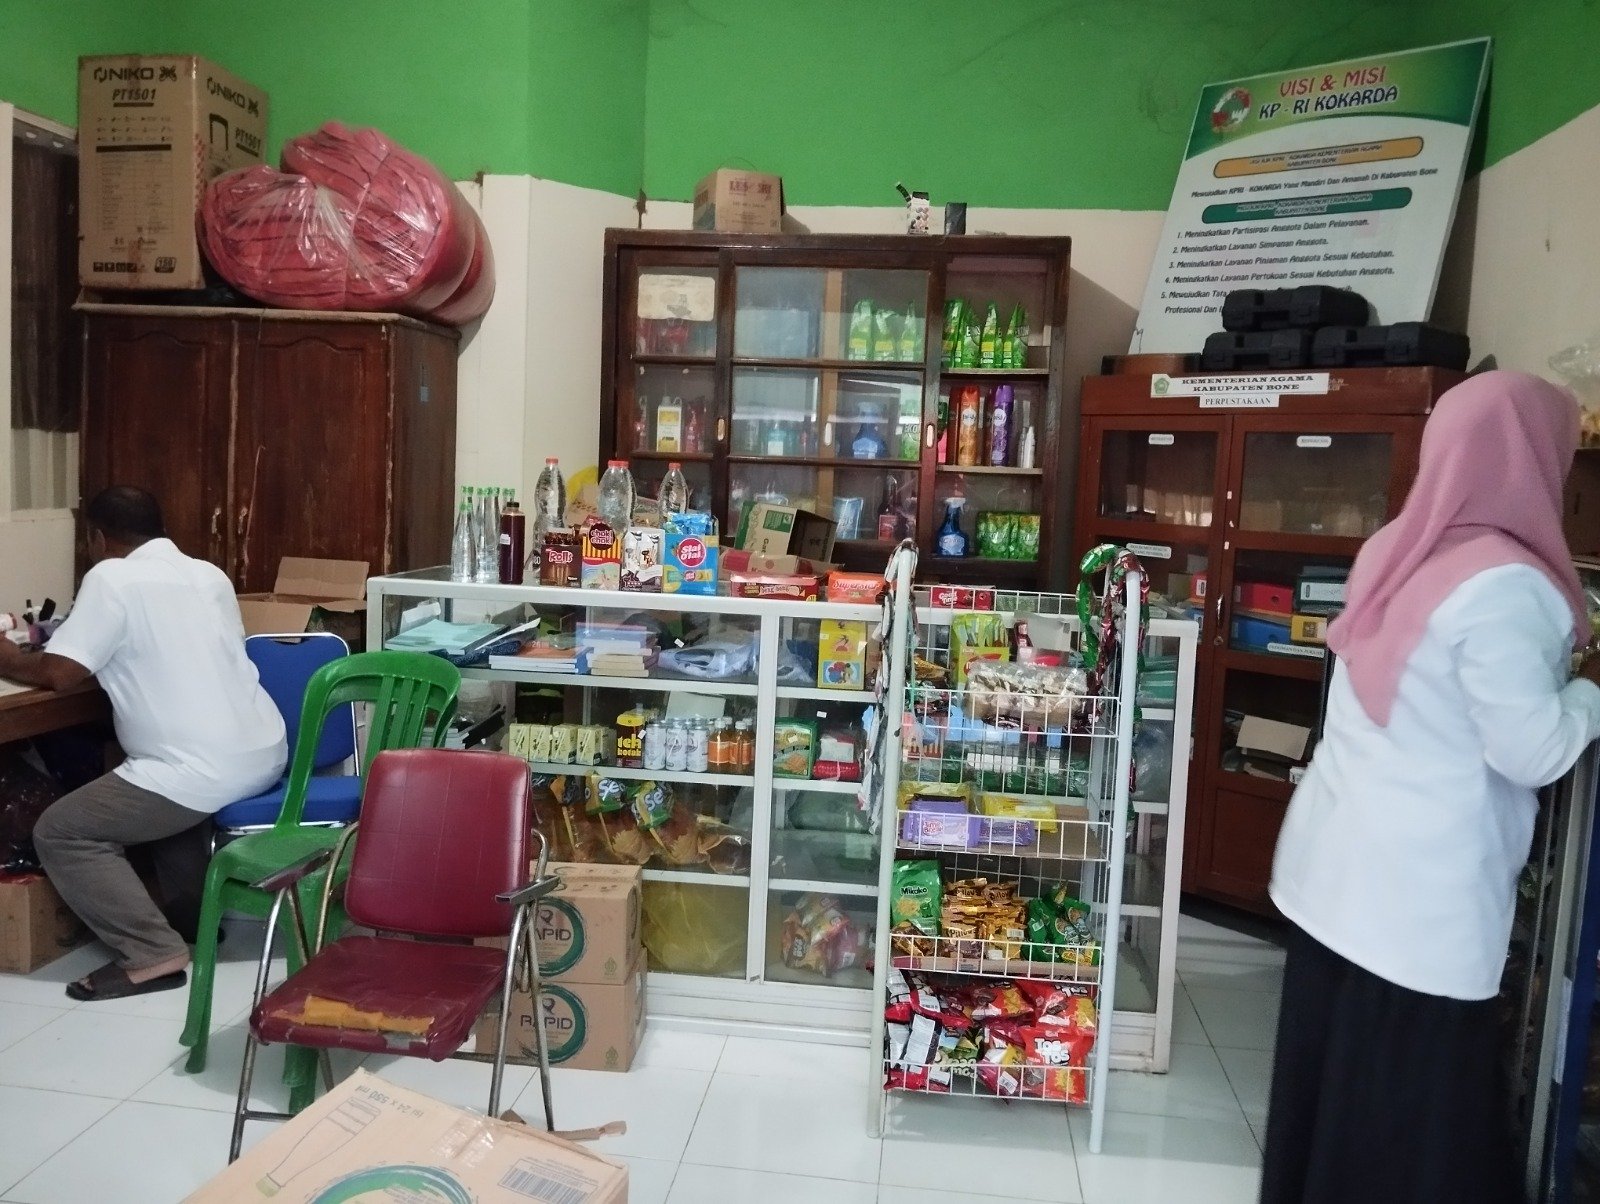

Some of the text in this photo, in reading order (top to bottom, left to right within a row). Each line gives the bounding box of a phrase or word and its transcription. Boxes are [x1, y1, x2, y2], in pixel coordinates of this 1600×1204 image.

[1280, 66, 1386, 97] VISI & MISI
[112, 88, 156, 101] PT1501
[1259, 103, 1281, 119] KP
[1293, 98, 1310, 114] RI
[1314, 86, 1398, 111] KOKARDA
[1300, 178, 1325, 187] Mandiri
[1419, 168, 1439, 176] Bone
[1184, 229, 1231, 238] Meningkatkan
[1303, 221, 1327, 230] Dalam
[1180, 244, 1227, 253] Meningkatkan
[1228, 243, 1257, 251] Layanan
[1259, 241, 1294, 250] Simpanan
[1176, 260, 1223, 269] Meningkatkan
[1224, 258, 1253, 267] Layanan
[1322, 252, 1349, 261] Sesuai
[1350, 250, 1395, 260] Kebutuhan.
[1172, 275, 1219, 284] Meningkatkan
[1220, 273, 1249, 282] Layanan
[1251, 271, 1288, 281] Pertokoan
[1289, 270, 1315, 279] Sesuai
[1316, 268, 1357, 278] Kebutuhan
[1211, 289, 1227, 298] Tata
[1164, 305, 1202, 314] Profesional
[1203, 305, 1218, 313] Dan
[1182, 375, 1314, 385] KEMENTERIAN AGAMA
[1193, 383, 1300, 392] KABUPATEN BONE
[1205, 397, 1271, 405] PERPUSTAKAAN
[548, 551, 573, 564] Rolls
[617, 733, 642, 749] teh
[617, 748, 642, 757] kotak
[368, 1091, 390, 1104] 550
[397, 1104, 412, 1114] 24
